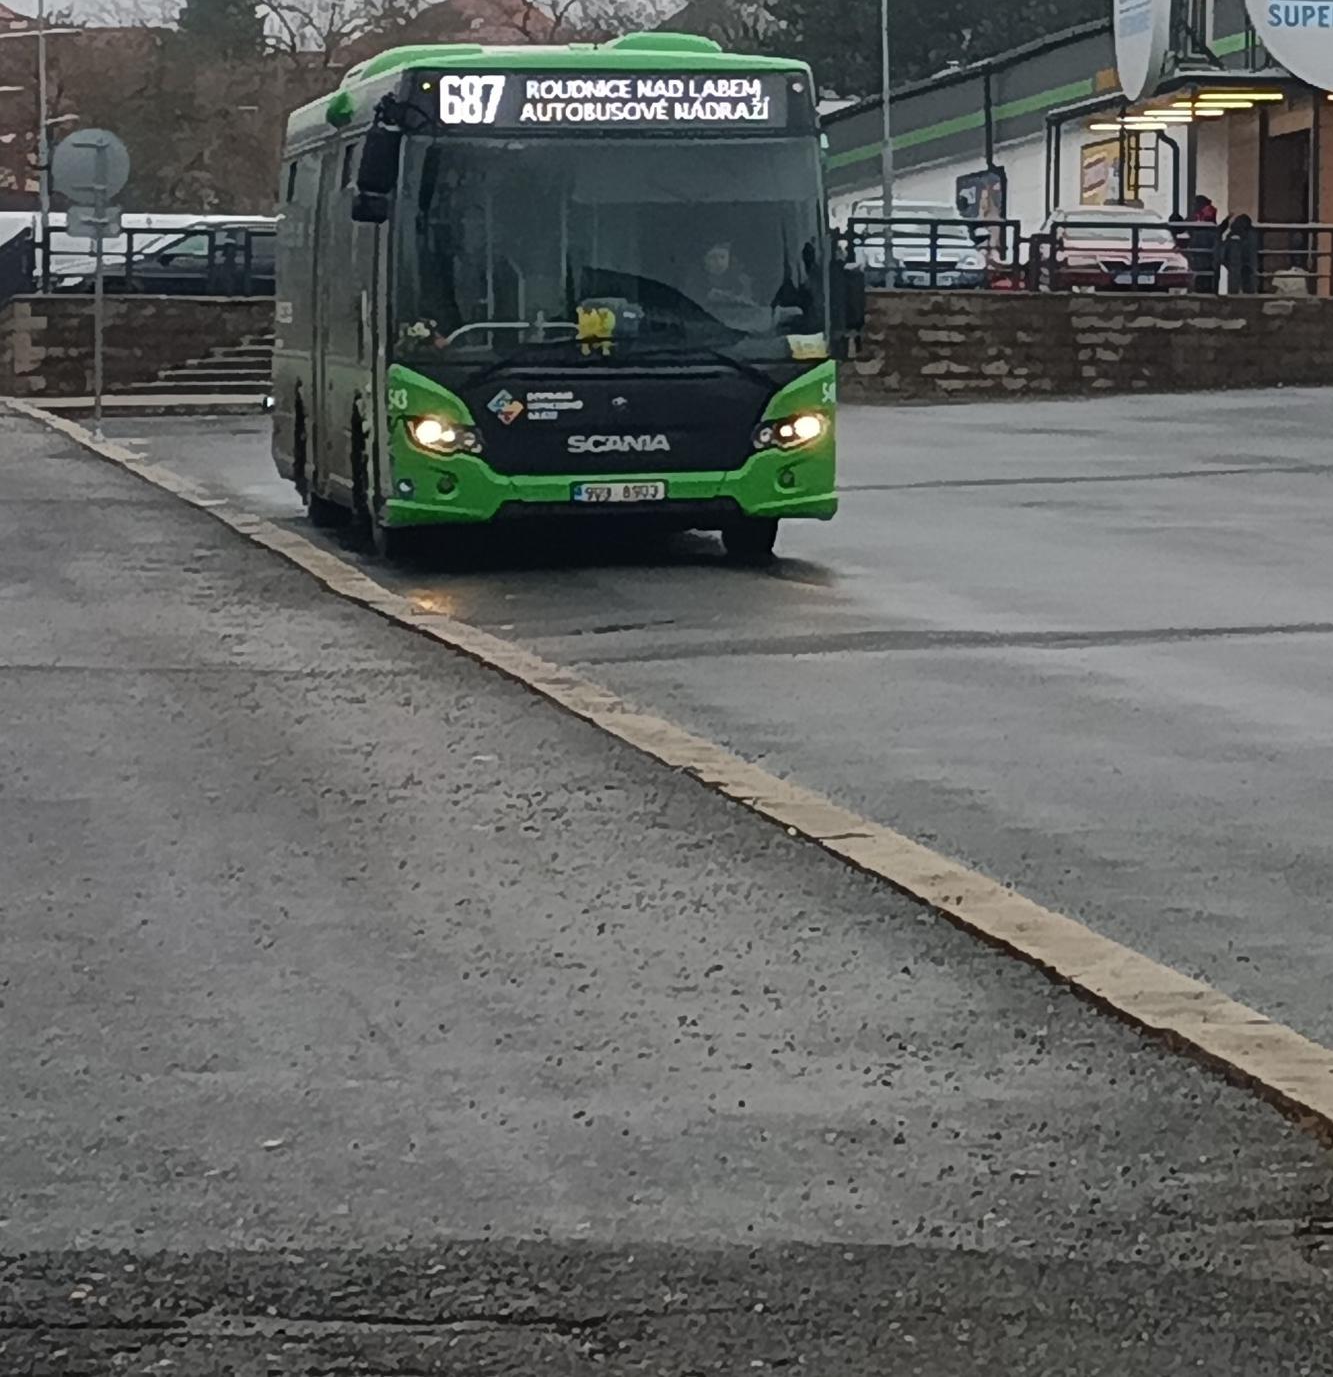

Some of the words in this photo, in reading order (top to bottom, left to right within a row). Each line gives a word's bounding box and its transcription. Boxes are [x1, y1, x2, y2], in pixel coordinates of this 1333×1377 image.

[439, 75, 506, 124] 687
[526, 79, 632, 99] ROUDNICE
[637, 79, 684, 98] NAD
[519, 98, 669, 121] AUTOBUSOVÉ
[567, 434, 671, 453] SCANIA
